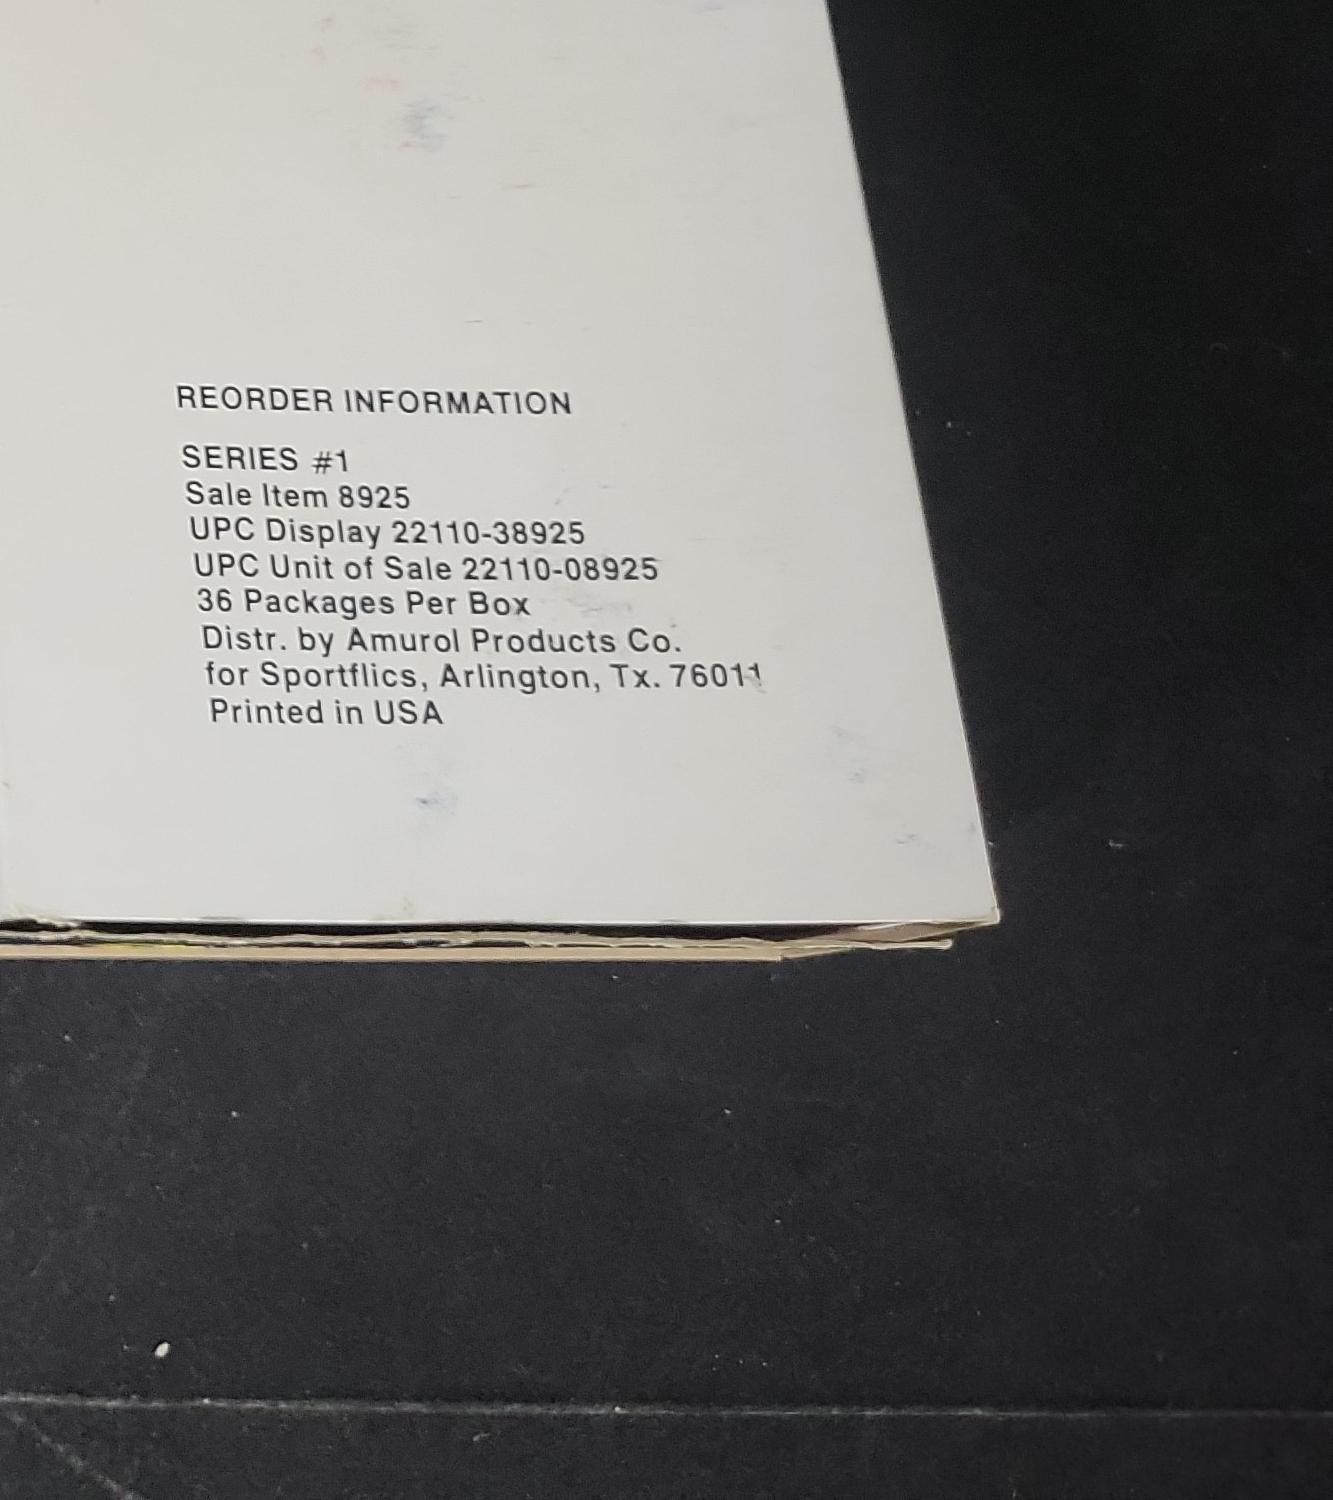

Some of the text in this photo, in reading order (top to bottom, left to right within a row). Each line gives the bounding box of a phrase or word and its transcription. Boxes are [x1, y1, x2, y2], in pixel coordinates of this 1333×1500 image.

[175, 385, 574, 416] REORDER INFORMATION
[182, 444, 349, 474] SERIES #1
[185, 480, 412, 511] Sale Item 8925
[190, 516, 586, 550] UPC Display 22110-38925
[194, 553, 660, 583] UPC Unit of Sale 22110-08925
[197, 588, 532, 621] 36 Packages Per Box
[202, 624, 682, 658] Distr. by Amurol Products Co.
[204, 661, 764, 695] for Sportflics, Arlington, Tx. 76011
[210, 699, 445, 727] Printed in USA
